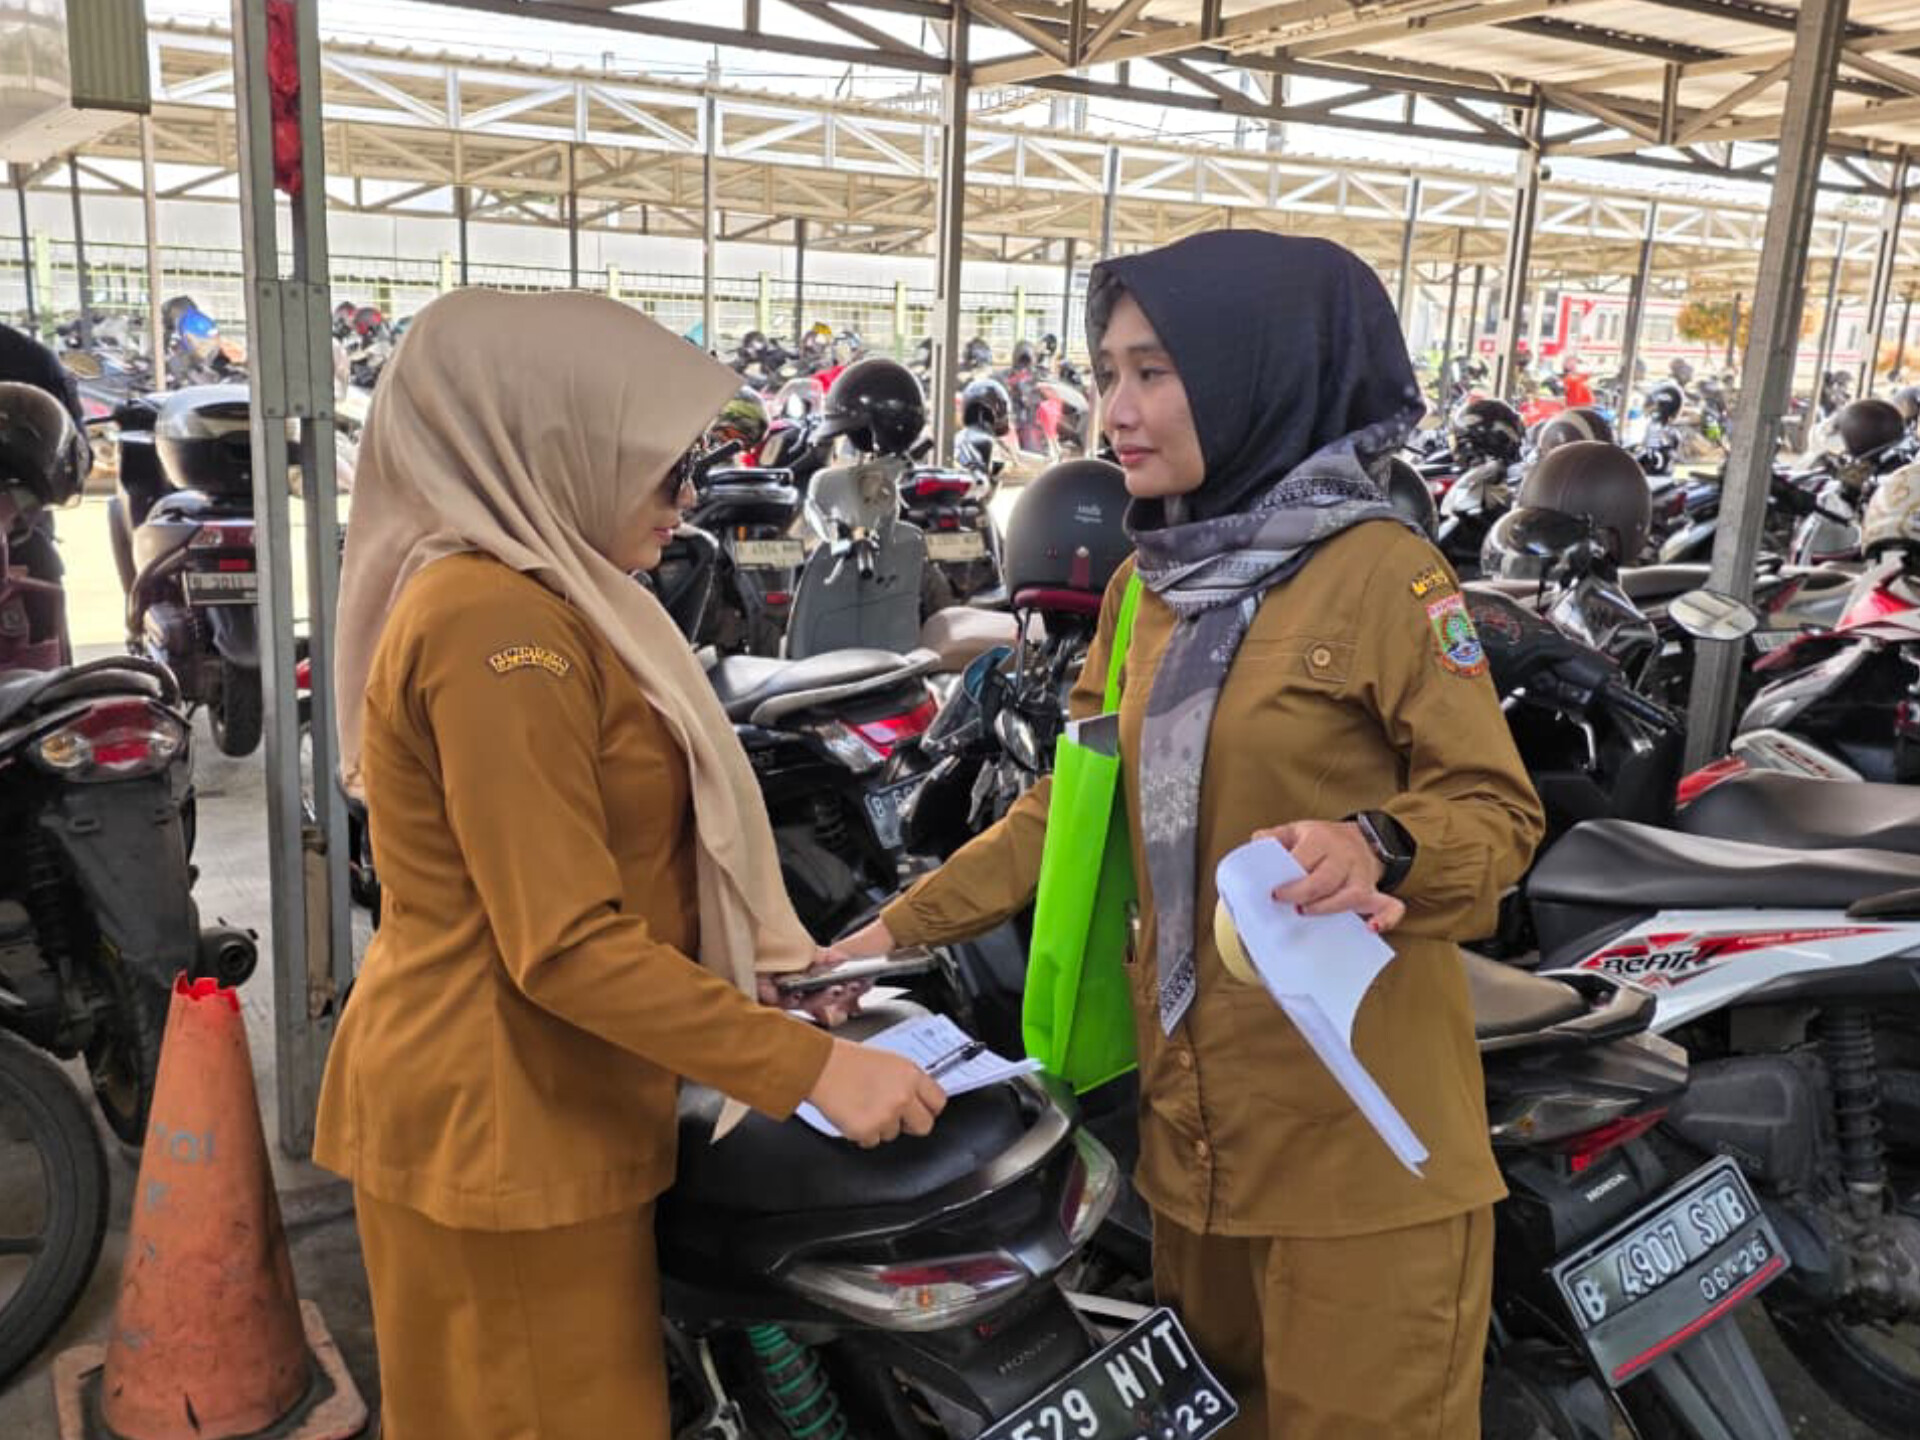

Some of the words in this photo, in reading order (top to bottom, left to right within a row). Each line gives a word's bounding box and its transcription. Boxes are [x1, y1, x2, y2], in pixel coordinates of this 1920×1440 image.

[1585, 1173, 1629, 1202] HONDA
[1575, 1277, 1607, 1322] B
[1617, 1223, 1688, 1297] 4907
[1689, 1186, 1746, 1246] STB
[1104, 1319, 1188, 1408] NYT
